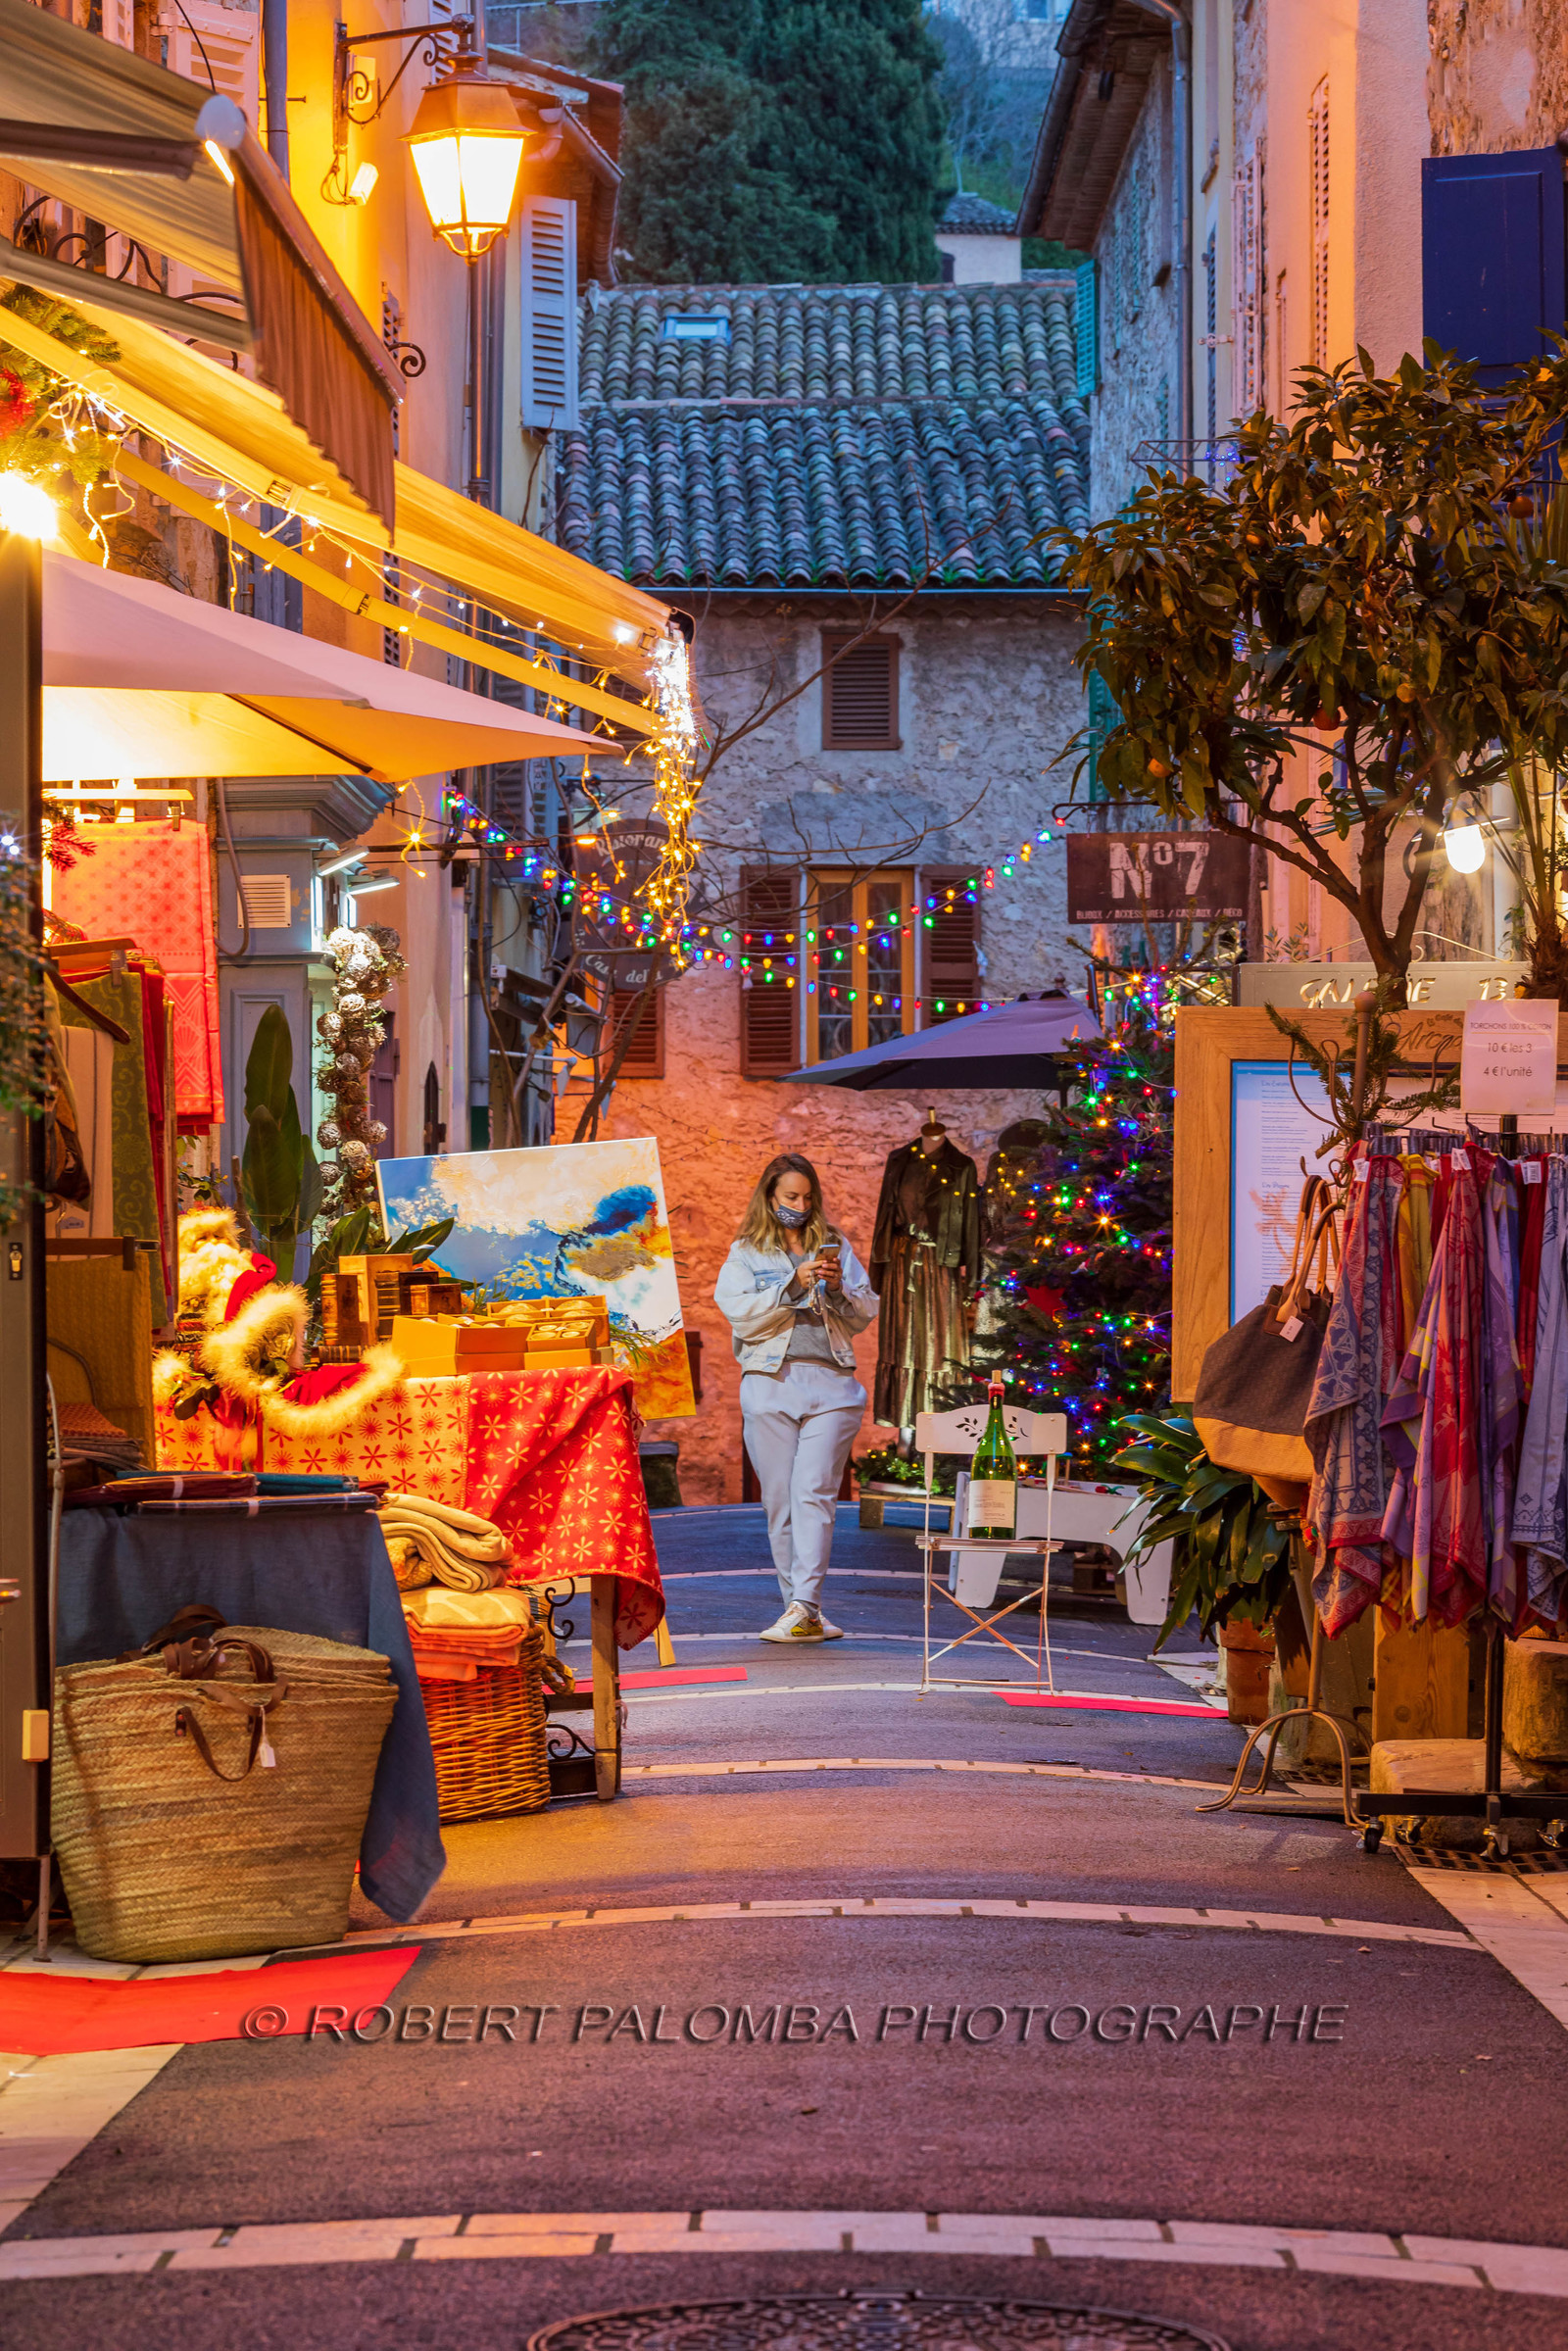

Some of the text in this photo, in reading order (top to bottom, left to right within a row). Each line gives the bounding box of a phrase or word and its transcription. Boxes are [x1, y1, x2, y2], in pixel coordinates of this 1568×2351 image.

[1114, 909, 1165, 918] ACCESSIRES
[1299, 977, 1436, 1008] GALIE
[1488, 1042, 1533, 1053] 10 € les 3
[1483, 1066, 1533, 1076] 4 € l'unité
